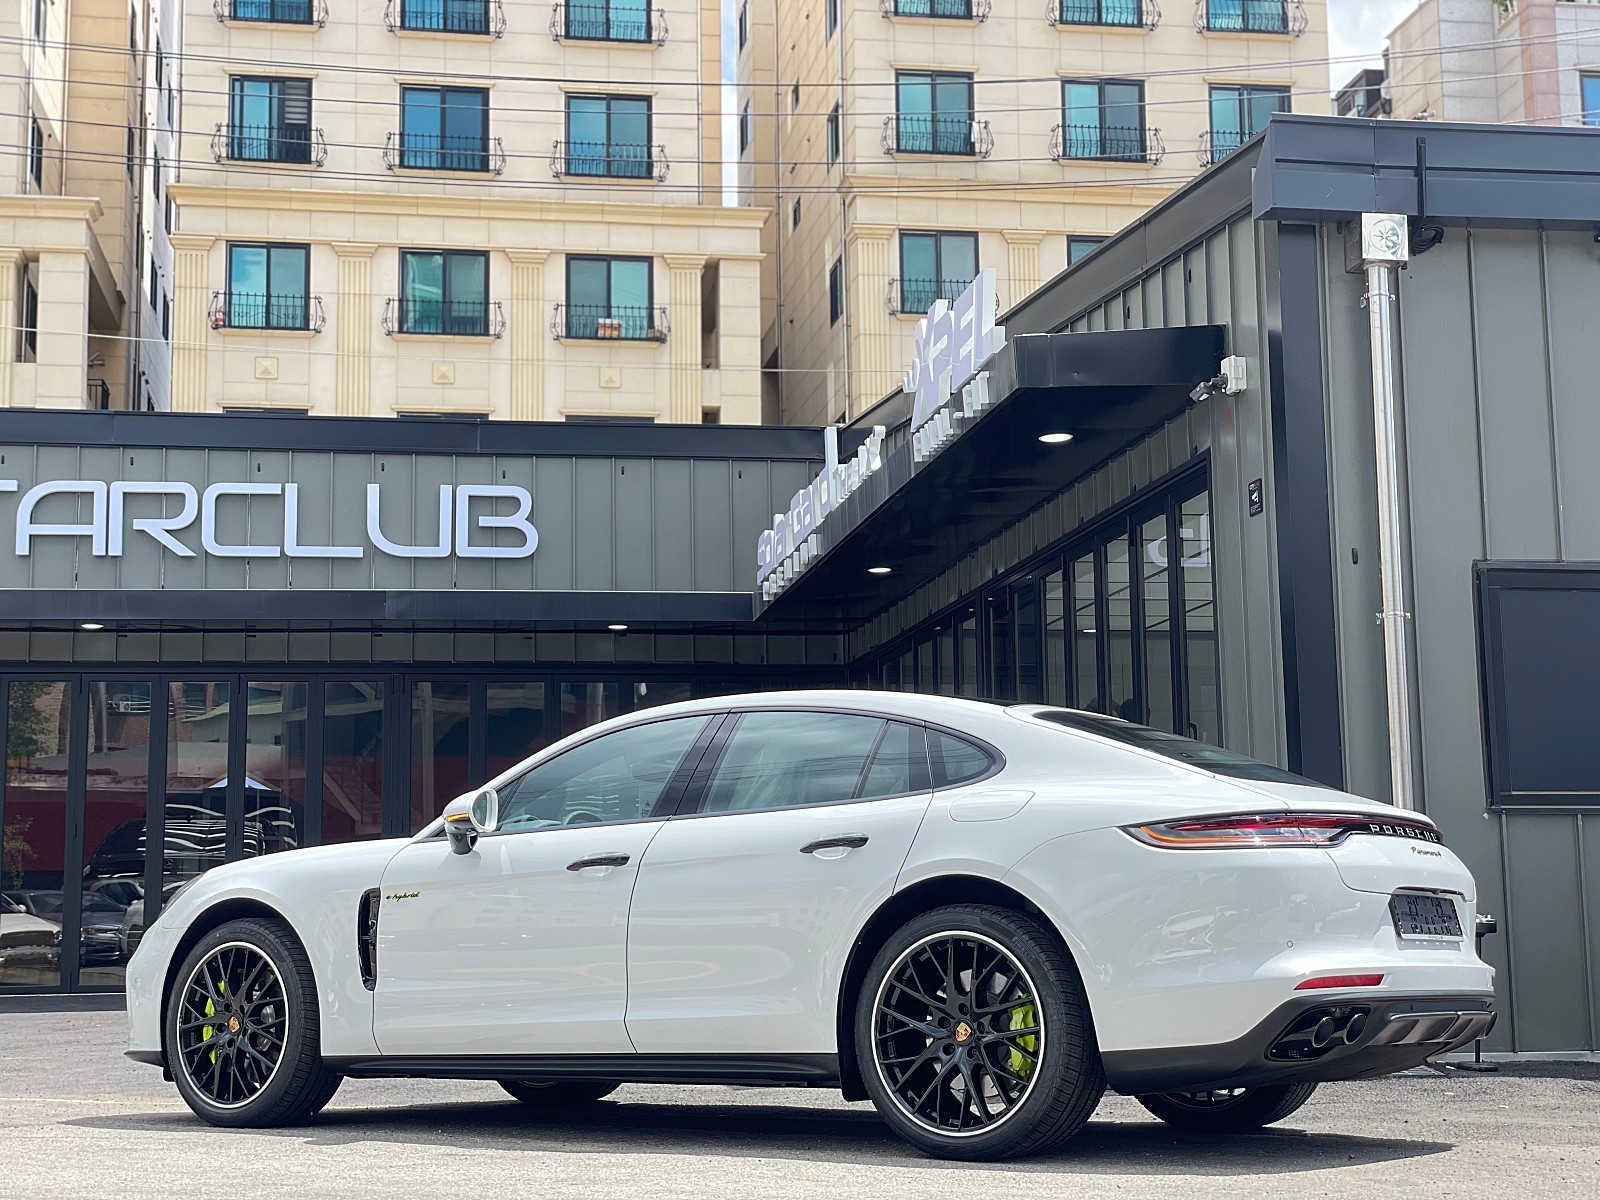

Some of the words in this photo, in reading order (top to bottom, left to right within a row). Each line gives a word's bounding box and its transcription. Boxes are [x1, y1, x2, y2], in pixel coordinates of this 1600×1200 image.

[911, 268, 1006, 433] XPEL
[0, 480, 539, 558] ARCLUB
[1369, 824, 1438, 842] PORSCHE
